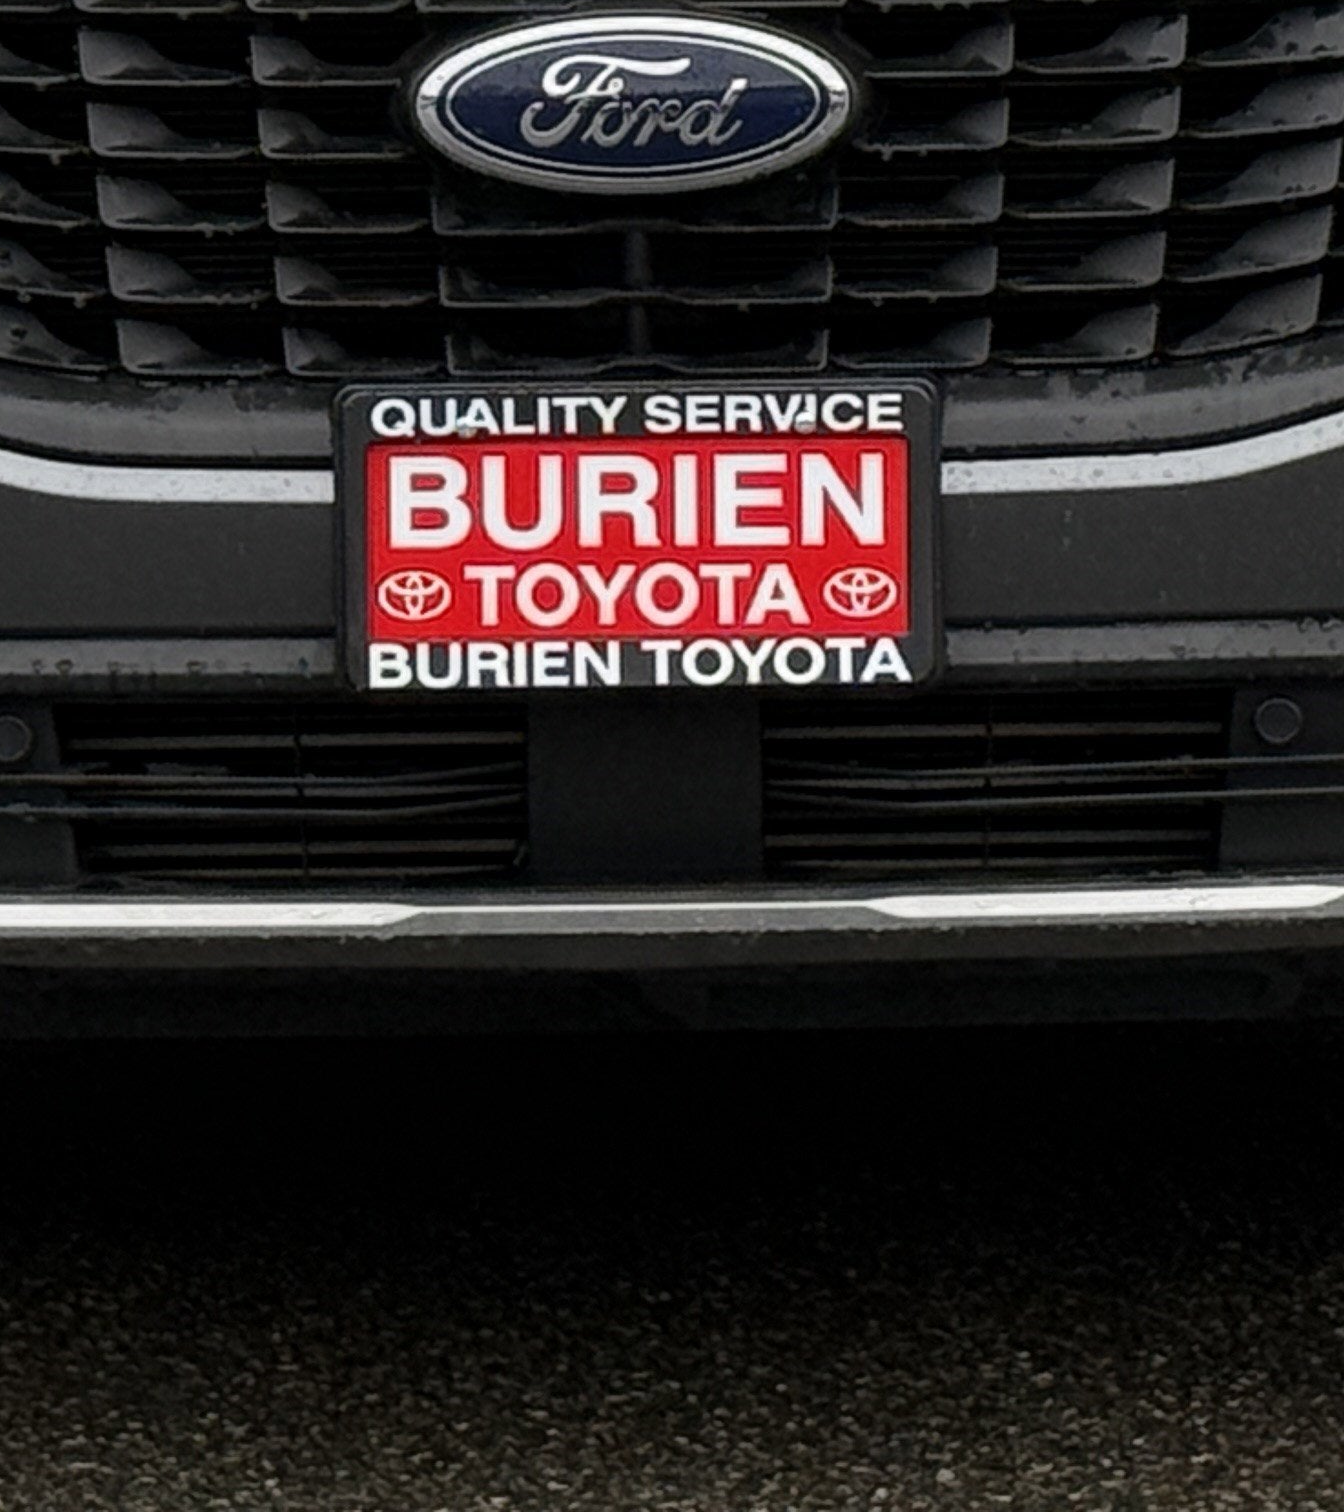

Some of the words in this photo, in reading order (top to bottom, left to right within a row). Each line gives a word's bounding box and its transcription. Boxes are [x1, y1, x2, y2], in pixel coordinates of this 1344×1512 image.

[520, 54, 748, 148] Ford
[371, 396, 627, 438] QUALITY
[643, 393, 903, 433] SERVICE
[388, 452, 886, 550] BURIEN
[463, 562, 812, 627] TOYOTA
[369, 642, 621, 688] BURIEN
[641, 637, 913, 686] TOYOTA
